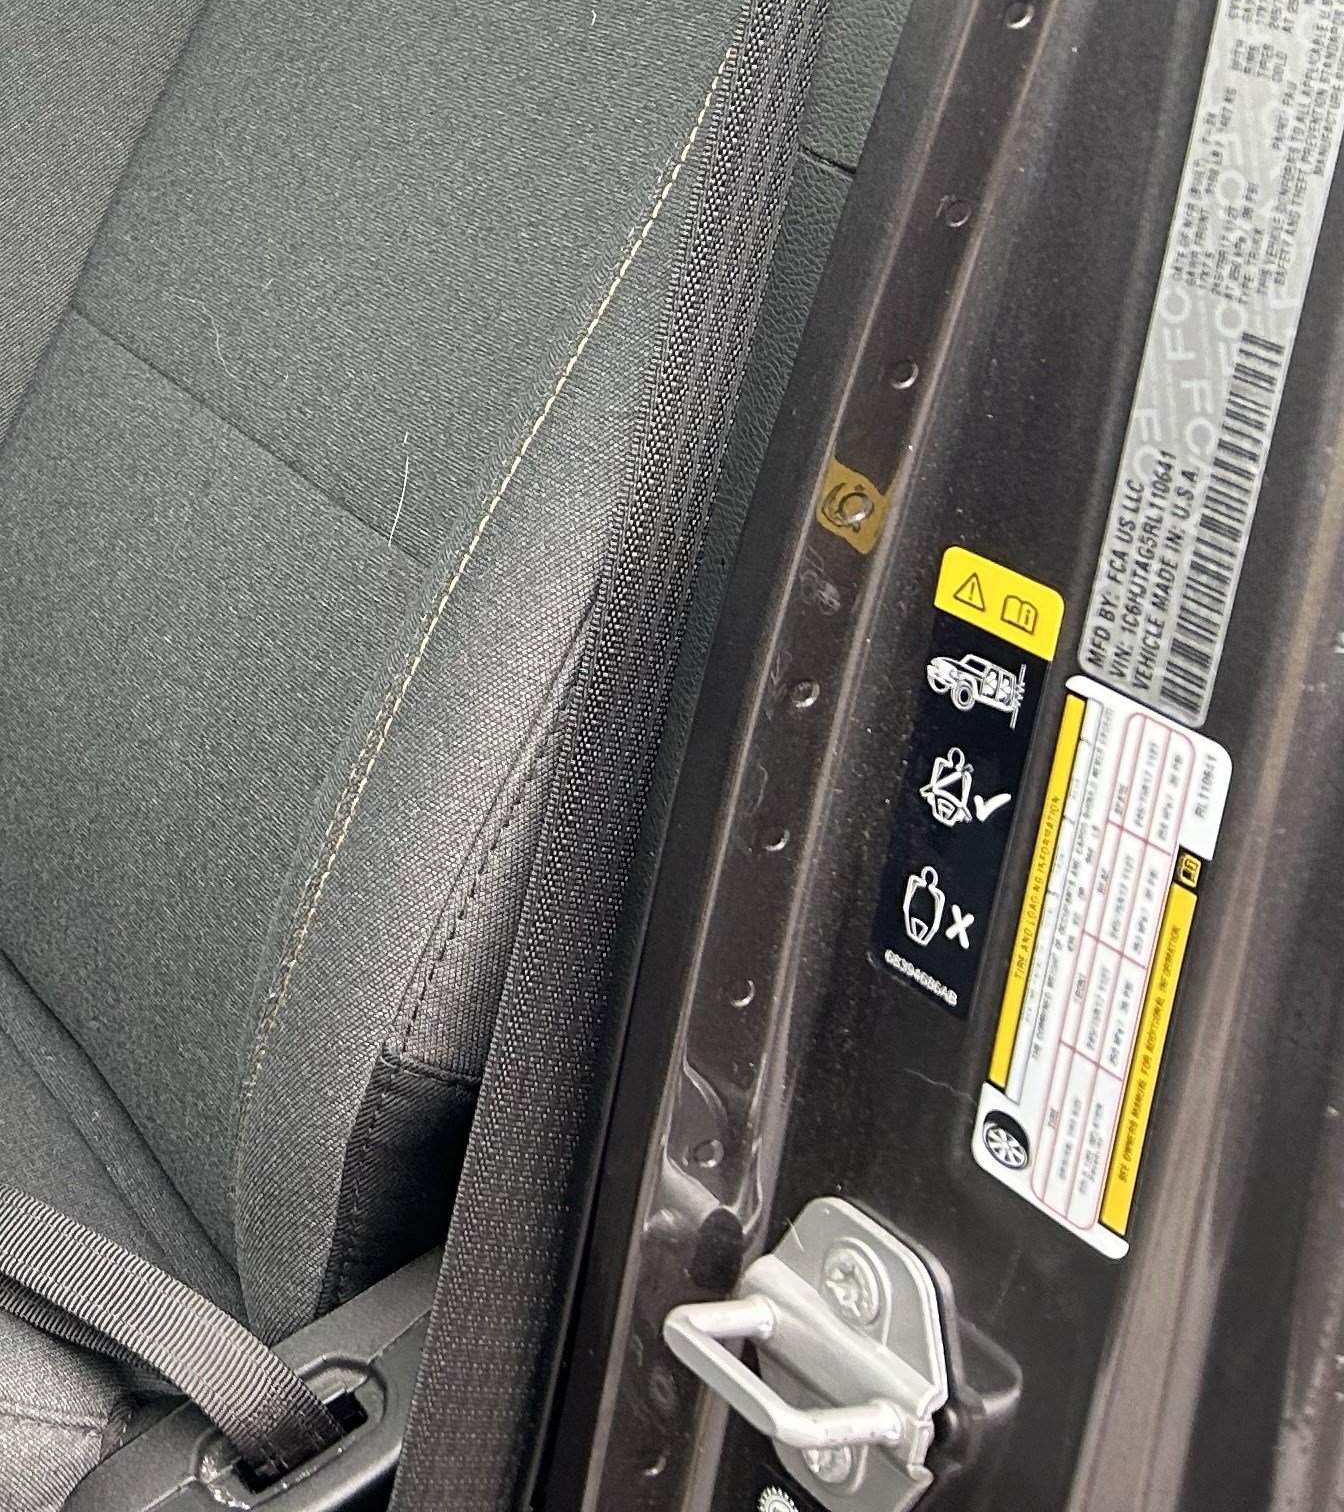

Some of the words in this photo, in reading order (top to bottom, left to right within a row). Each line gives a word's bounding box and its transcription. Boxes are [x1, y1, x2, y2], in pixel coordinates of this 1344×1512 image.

[1121, 478, 1144, 514] LLC
[1115, 516, 1136, 544] US
[1120, 449, 1177, 635] 1C6HJTAG5RL110641
[1106, 549, 1128, 584] FCA
[1097, 591, 1119, 622] BY:
[1132, 616, 1164, 690] VEHICLE
[1151, 557, 1177, 612] MADE
[1164, 526, 1184, 553] IN:
[1087, 625, 1110, 668] MFD
[1108, 642, 1133, 678] VIN:
[1013, 954, 1027, 978] TIRE
[1020, 927, 1033, 952] AND
